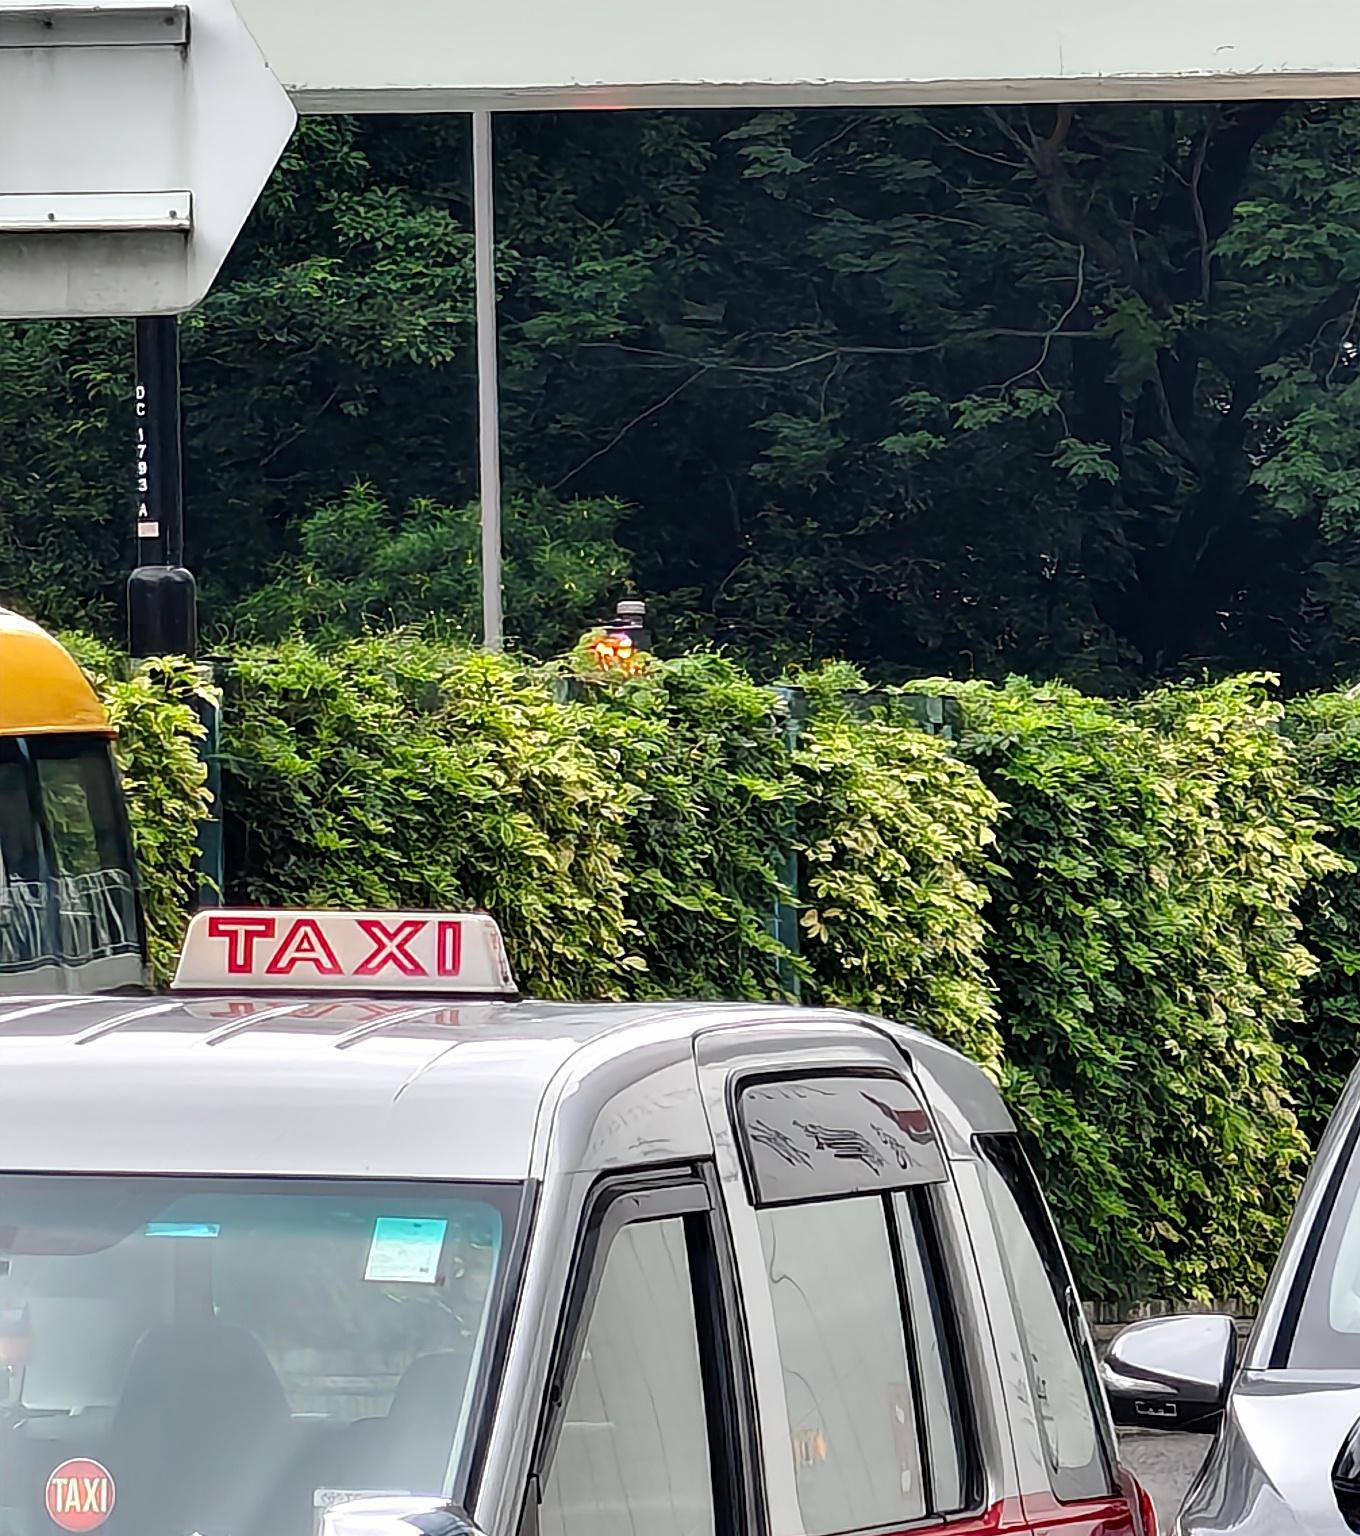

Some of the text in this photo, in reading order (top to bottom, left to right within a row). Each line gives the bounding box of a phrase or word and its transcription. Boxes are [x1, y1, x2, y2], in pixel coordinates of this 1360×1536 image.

[135, 385, 146, 416] DC
[138, 502, 149, 518] A
[208, 916, 462, 977] TAXI
[51, 1477, 108, 1513] TAXI
